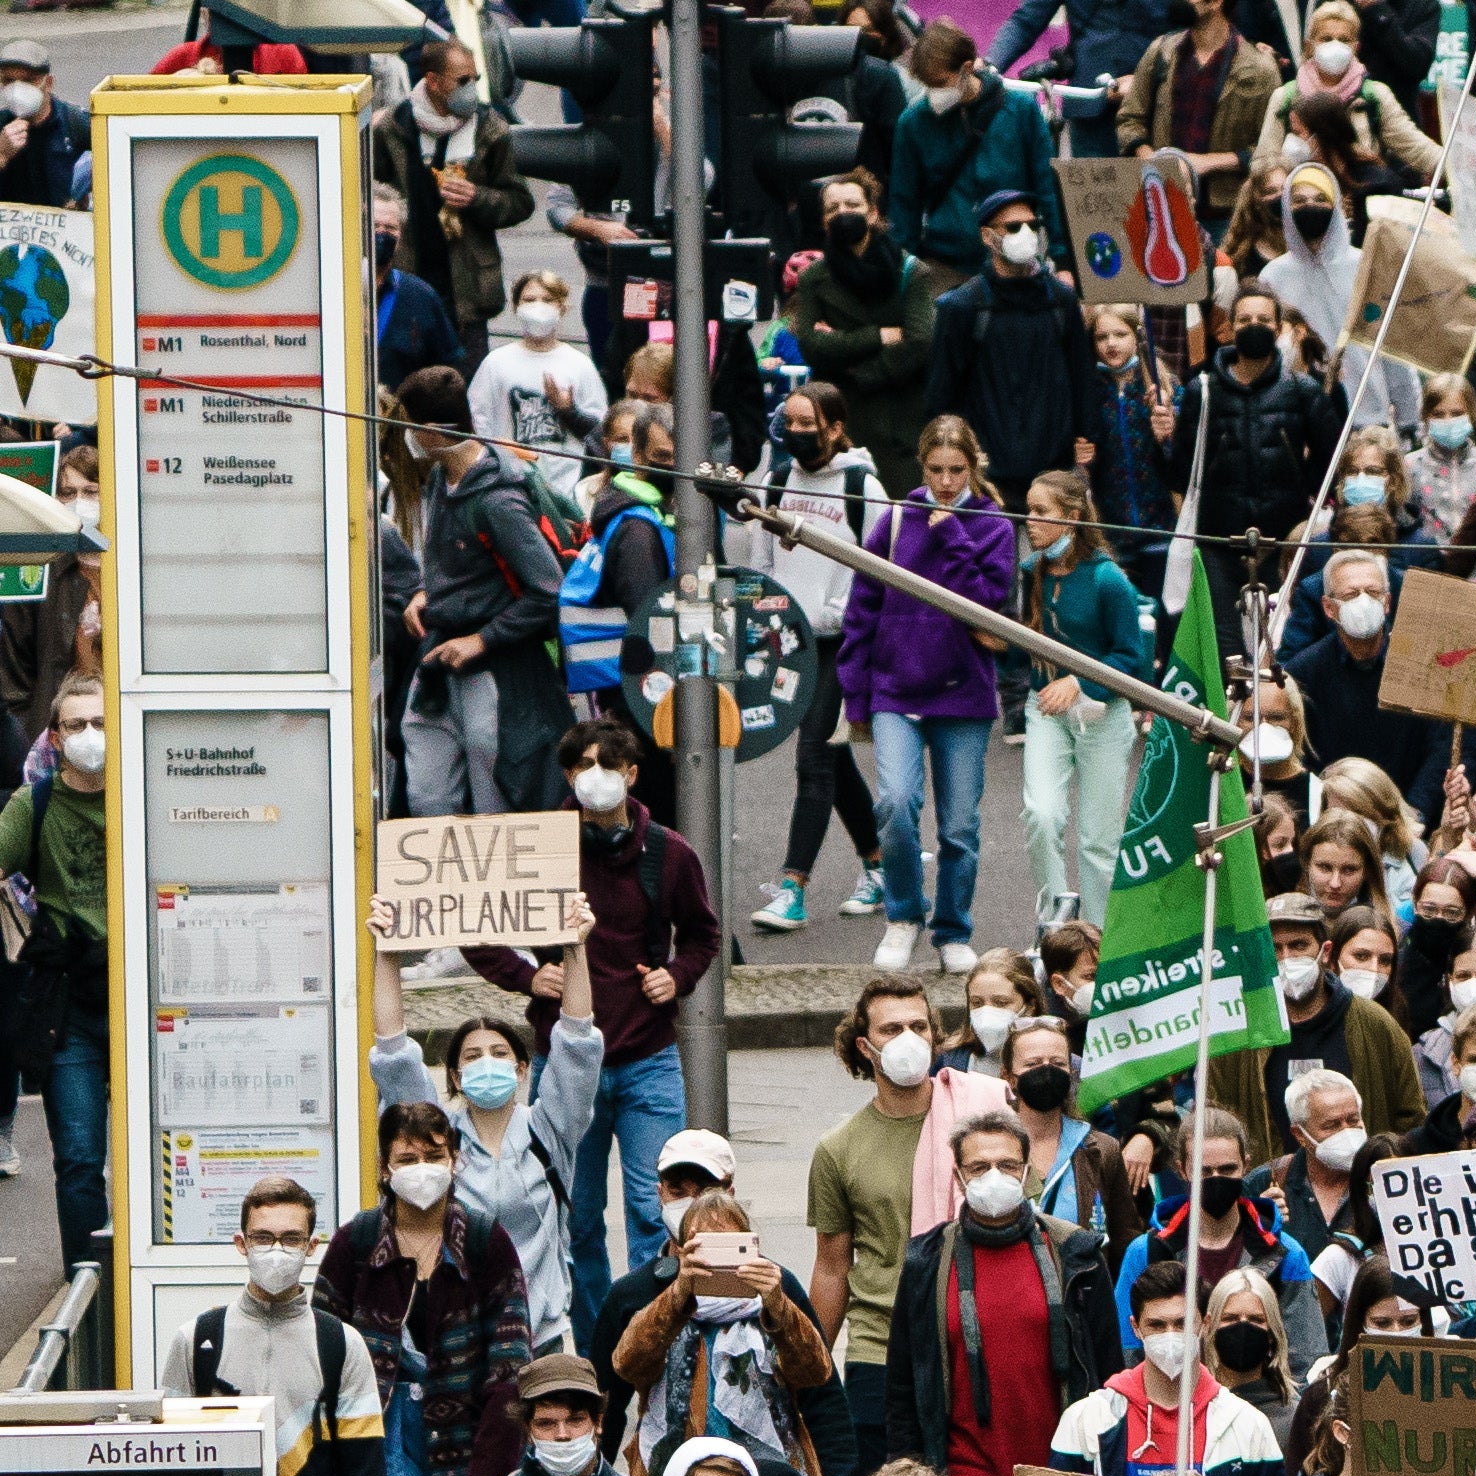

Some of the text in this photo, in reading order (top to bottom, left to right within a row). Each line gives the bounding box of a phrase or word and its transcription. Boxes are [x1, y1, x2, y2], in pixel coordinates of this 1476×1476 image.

[611, 200, 631, 213] F5
[199, 186, 263, 258] H
[159, 337, 183, 352] M1
[274, 334, 307, 347] Nord
[160, 397, 184, 413] M1
[202, 410, 293, 426] Schillerstraße
[163, 456, 276, 474] 12 Weißensee
[203, 472, 294, 487] Pasedagplatz
[166, 763, 267, 778] Friedrichstraße
[172, 807, 250, 821] Tarifbereich
[395, 824, 540, 886] SAVE
[440, 887, 578, 934] PLANET
[88, 1441, 218, 1467] Abfahrt in
